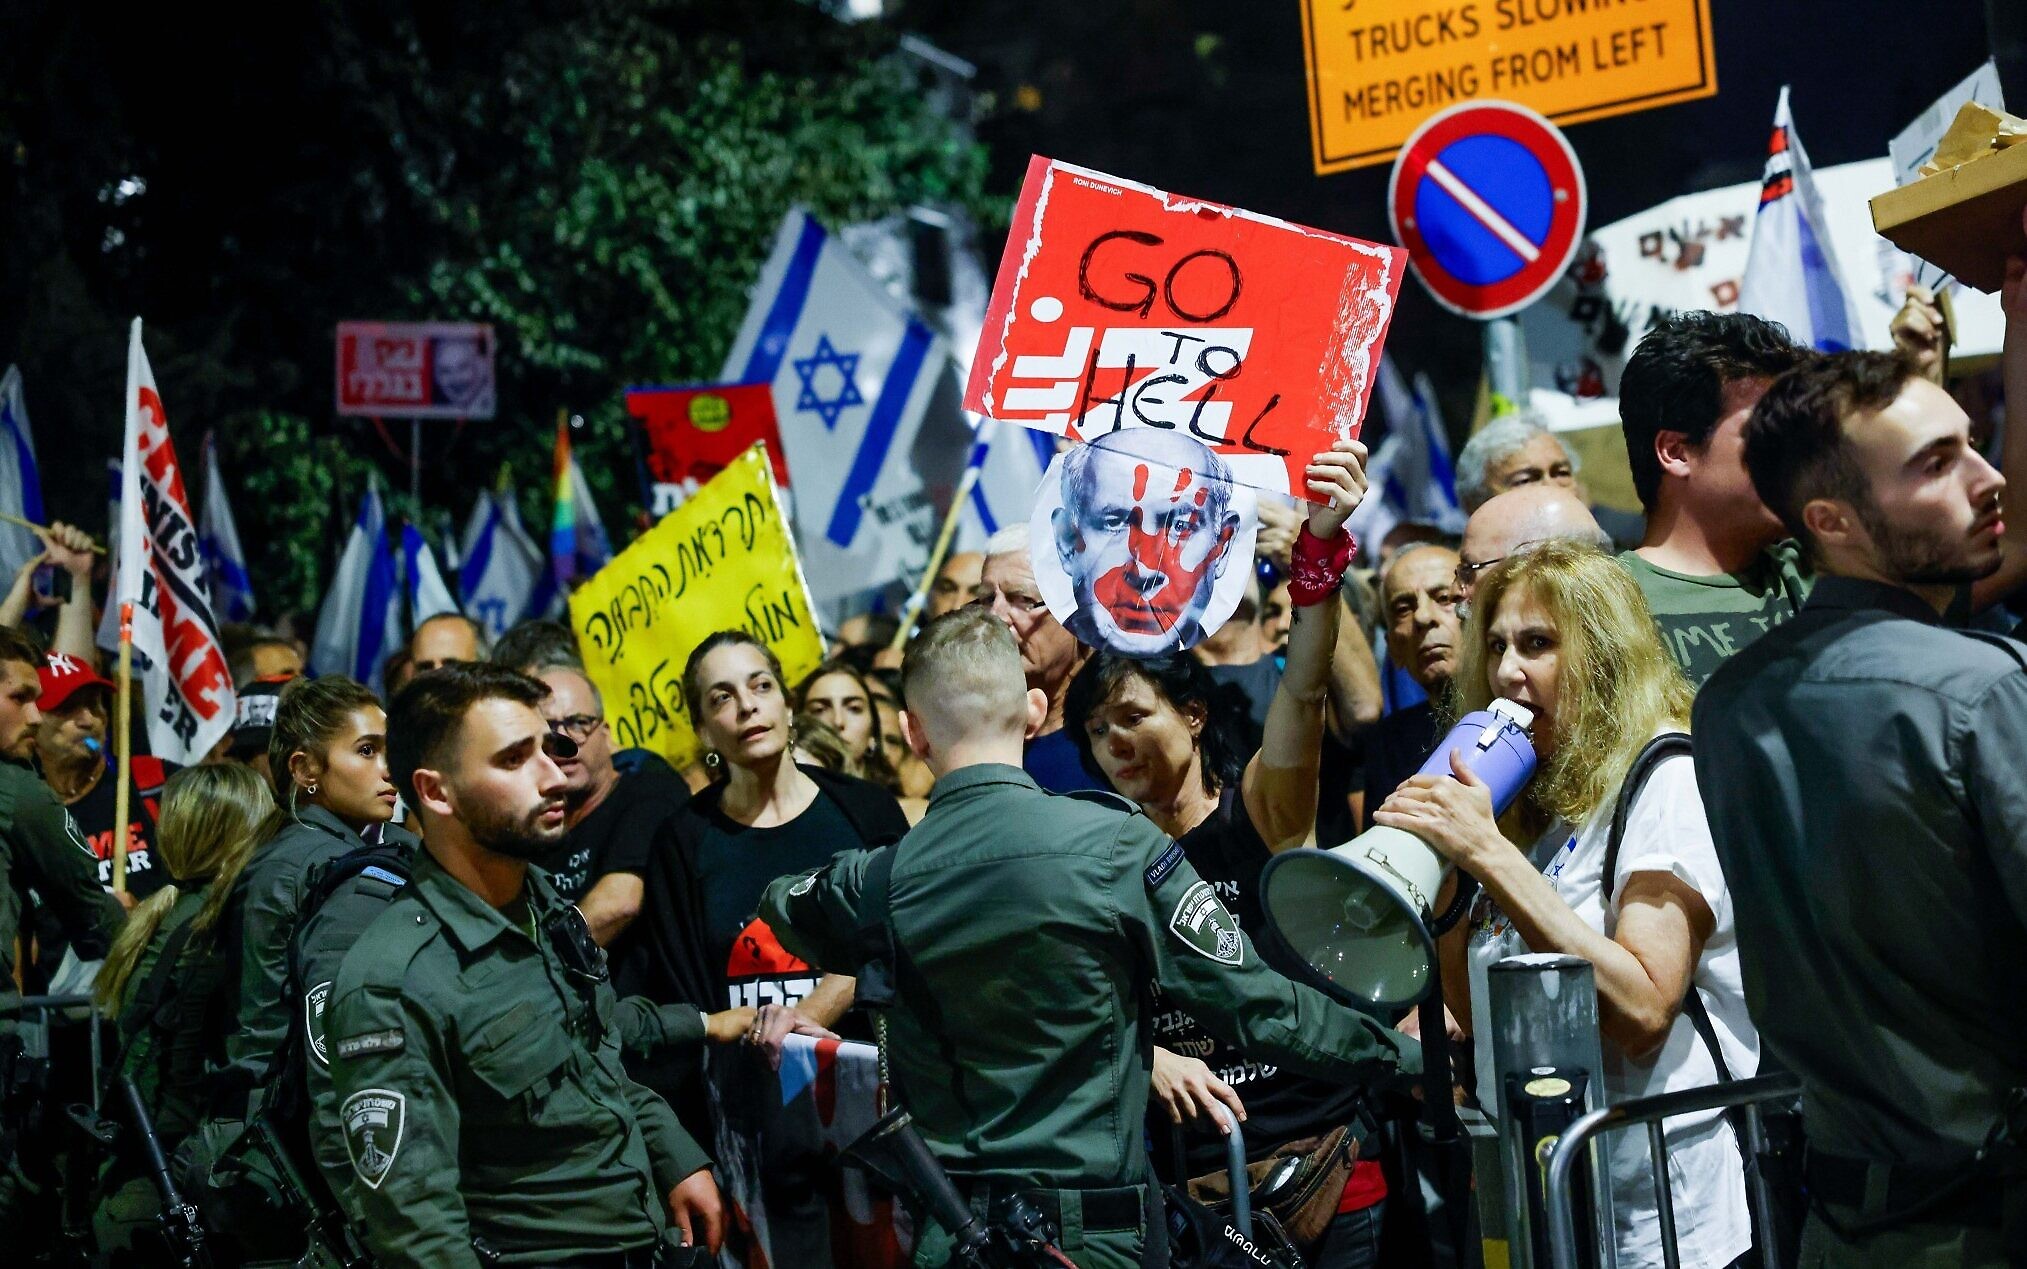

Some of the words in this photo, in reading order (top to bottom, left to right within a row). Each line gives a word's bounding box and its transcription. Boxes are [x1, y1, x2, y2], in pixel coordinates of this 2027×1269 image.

[1350, 4, 1480, 62] TRUCKS
[1343, 65, 1479, 122] MERGING
[1492, 46, 1579, 92] FROM
[1592, 22, 1668, 71] LEFT
[1072, 177, 1090, 188] RONI
[1078, 230, 1244, 323] GO
[1160, 331, 1242, 380] TO
[1077, 348, 1291, 457] HELL
[1224, 1224, 1272, 1266] משטרה
